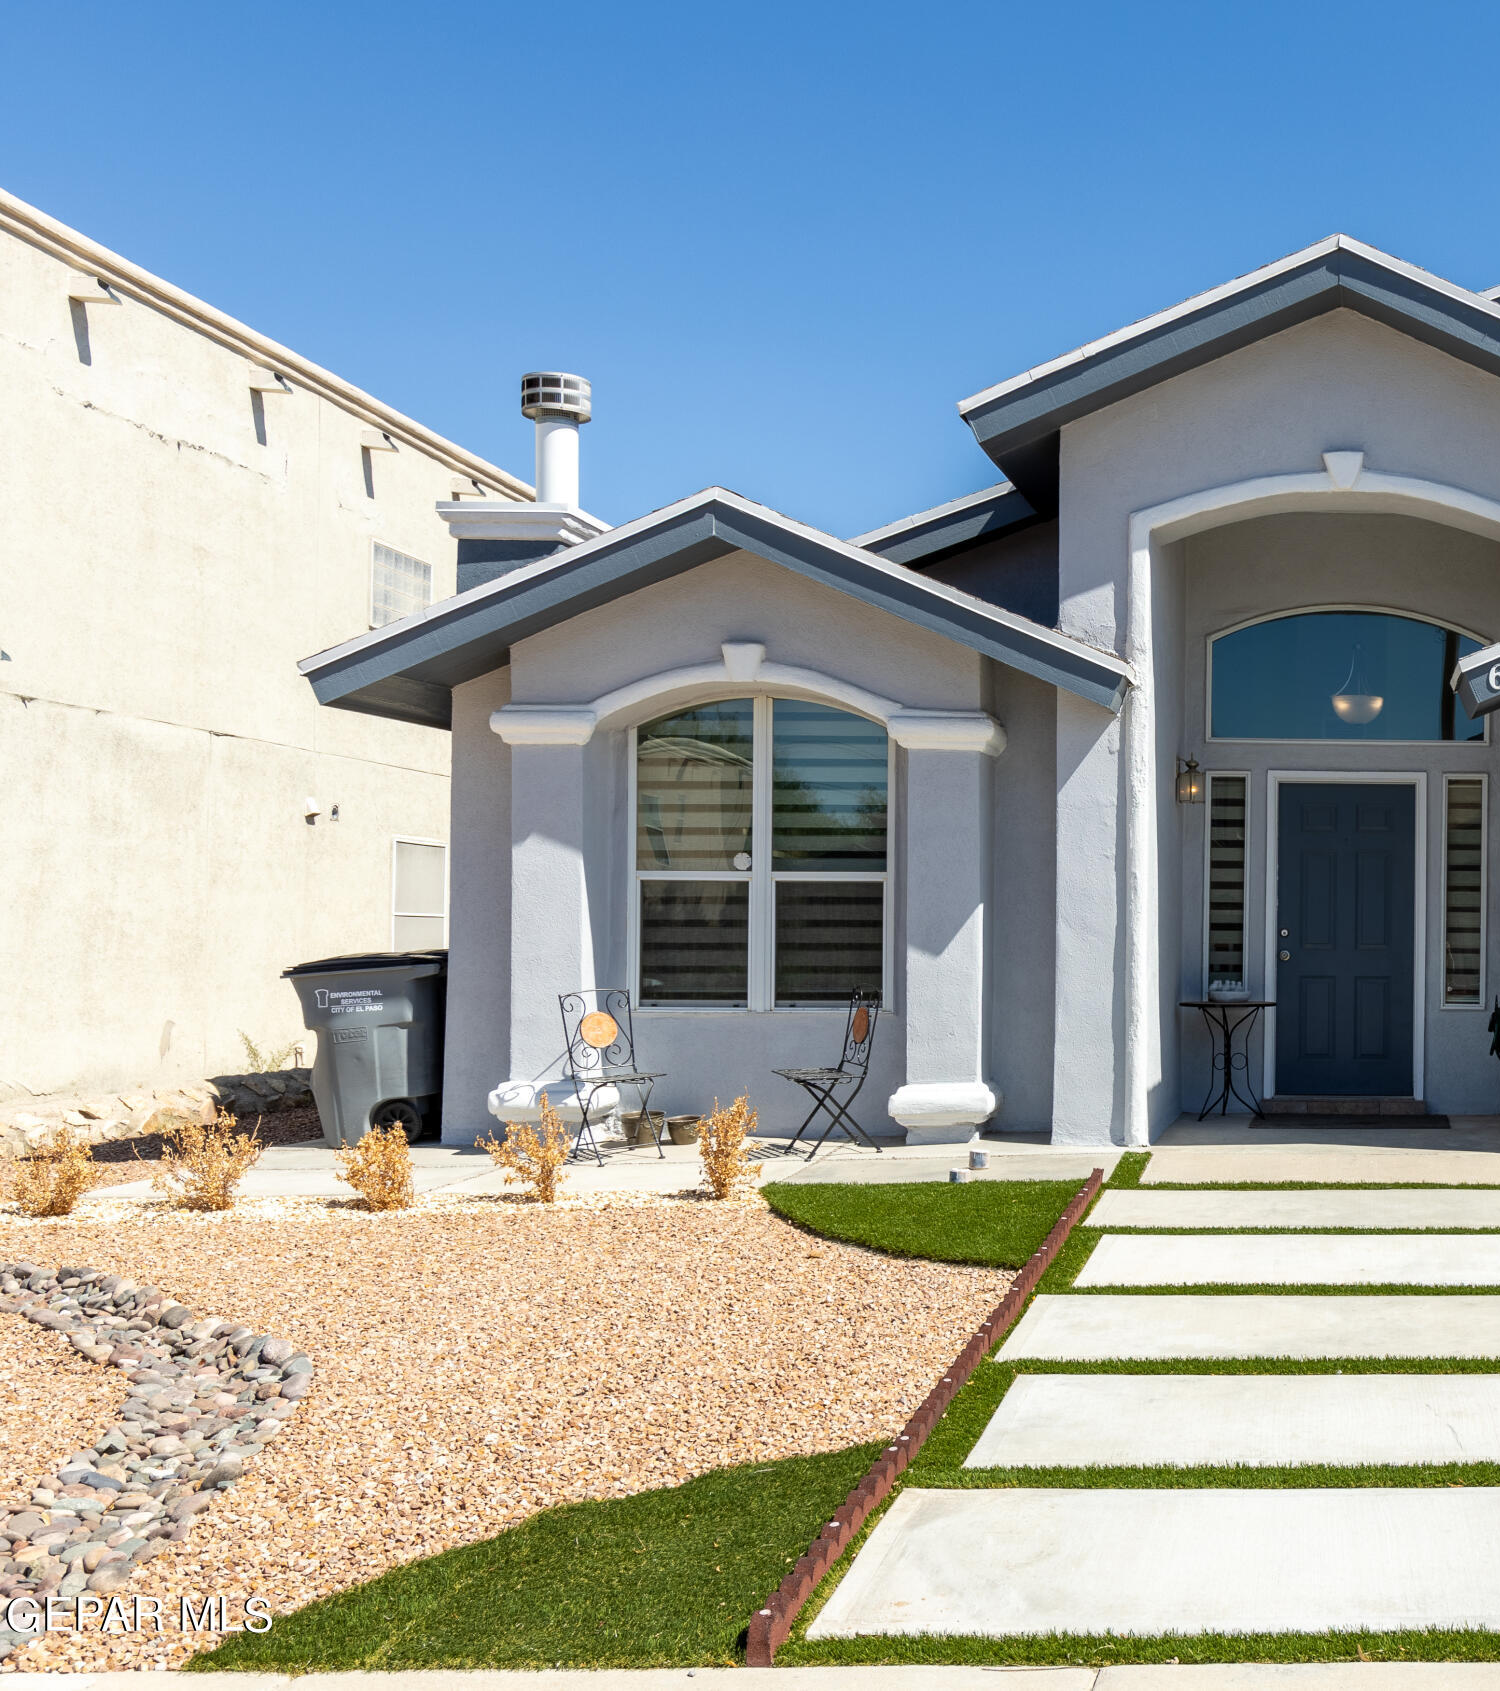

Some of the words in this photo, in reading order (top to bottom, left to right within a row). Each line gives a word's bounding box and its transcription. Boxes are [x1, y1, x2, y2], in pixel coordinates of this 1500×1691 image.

[330, 990, 383, 999] ENVIRONMENTAL
[341, 997, 372, 1005] SERVICES
[365, 1004, 383, 1012] PASO
